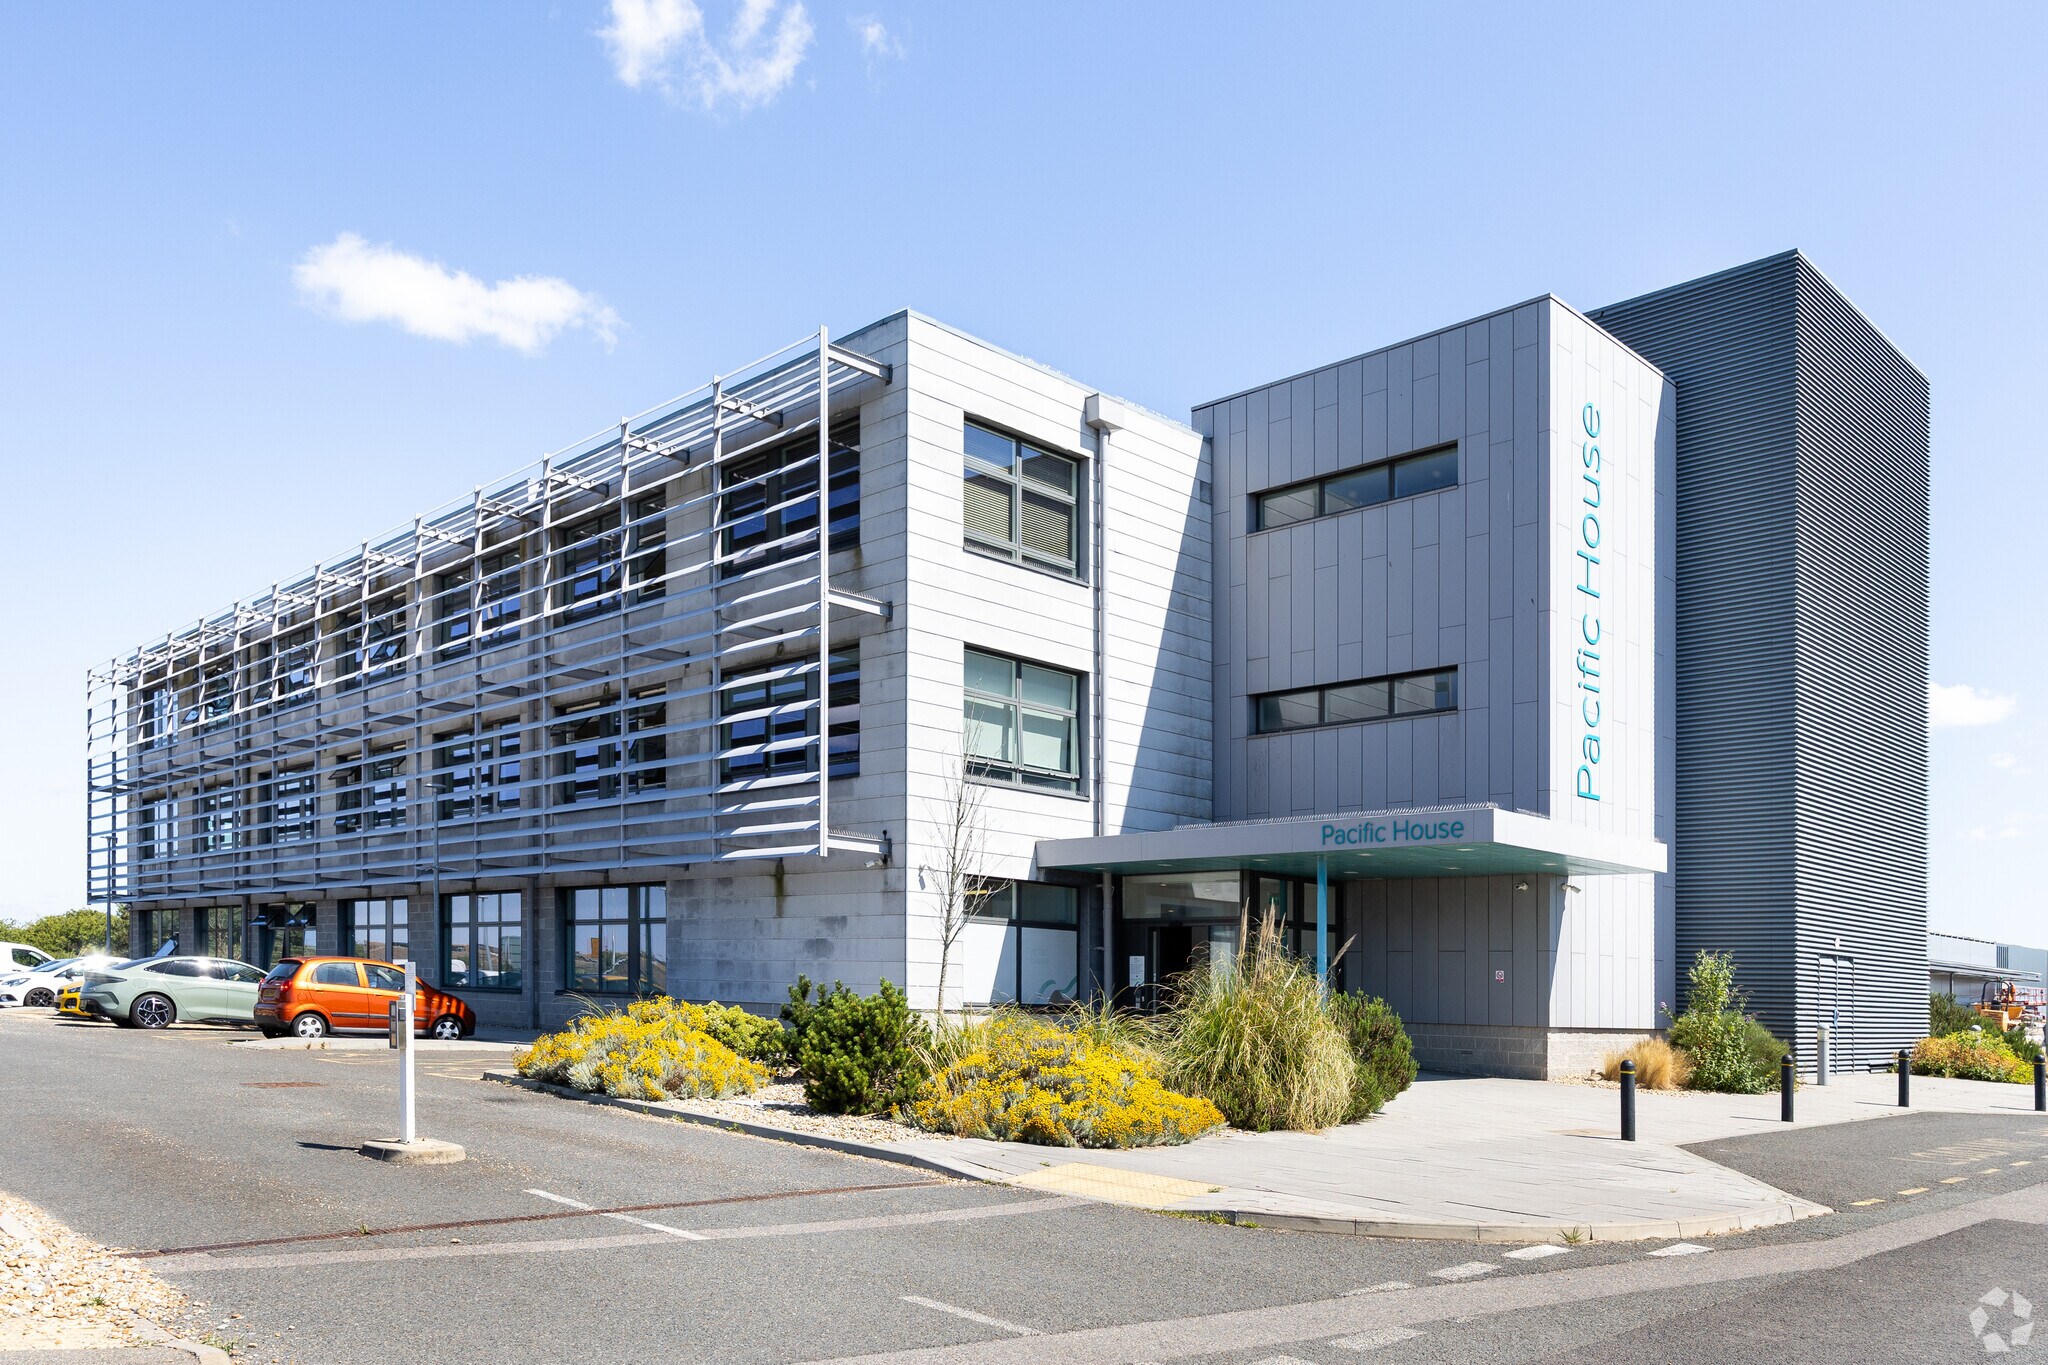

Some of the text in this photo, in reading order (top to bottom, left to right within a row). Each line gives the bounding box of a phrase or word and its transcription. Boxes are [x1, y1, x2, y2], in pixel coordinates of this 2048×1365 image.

[1576, 402, 1601, 801] Pacific House
[1321, 820, 1465, 846] Pacific House
